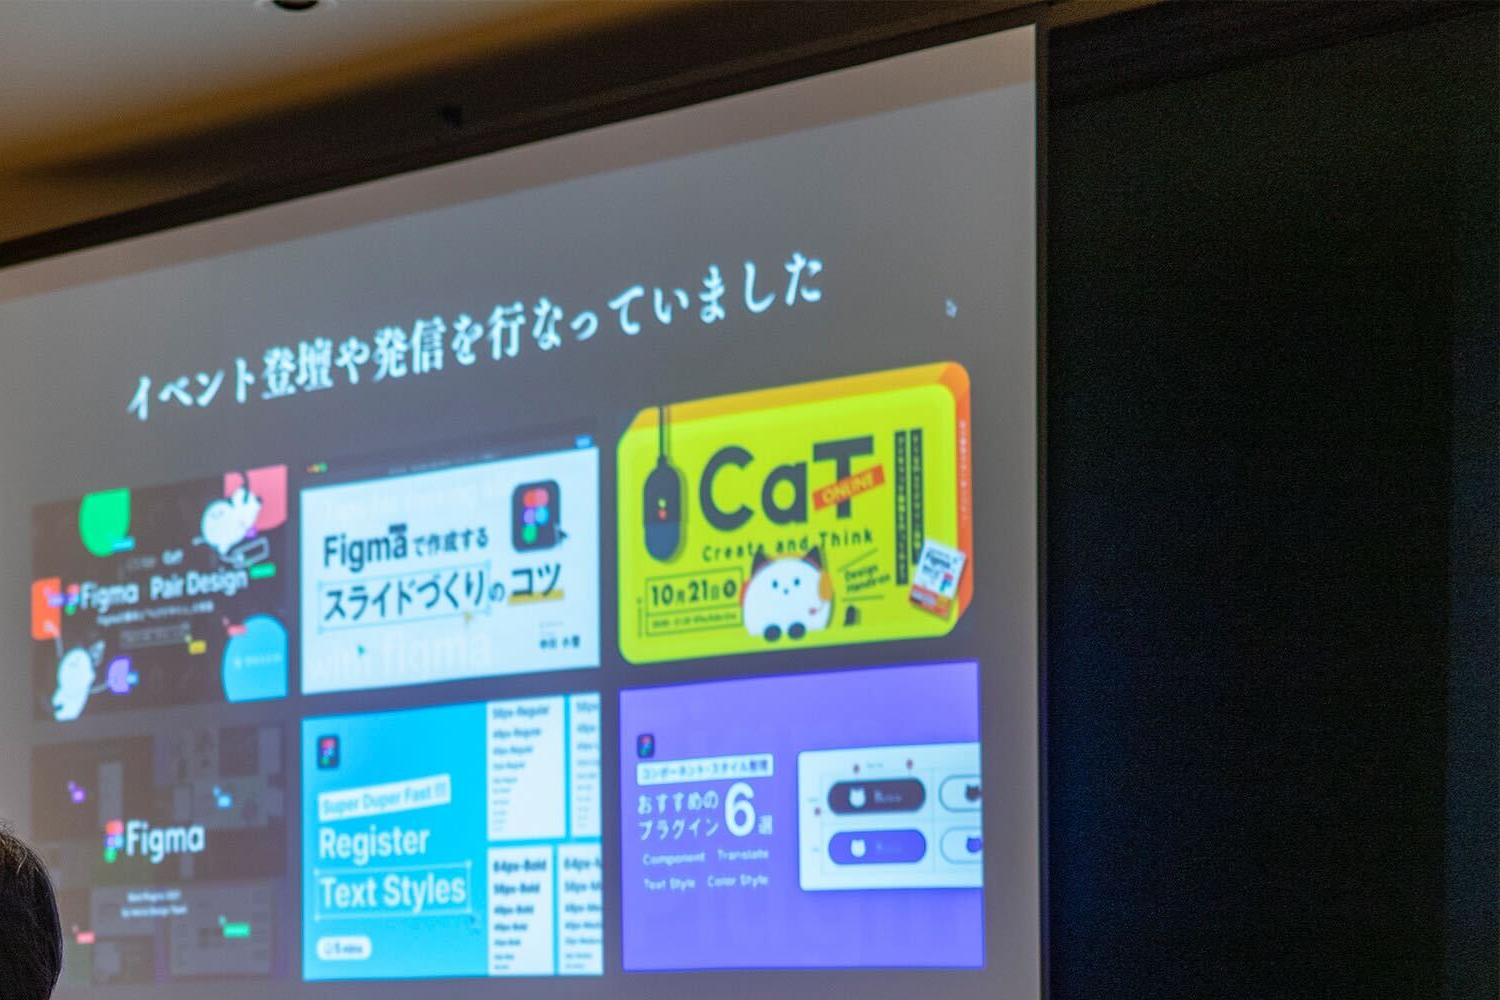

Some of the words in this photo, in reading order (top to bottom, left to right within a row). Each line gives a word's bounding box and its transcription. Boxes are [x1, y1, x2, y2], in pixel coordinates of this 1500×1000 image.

[127, 252, 823, 421] イベント登壇や発信を行なっていました
[700, 436, 874, 532] CaT
[776, 536, 808, 552] and
[819, 529, 873, 549] Think
[81, 580, 139, 614] Figma
[150, 573, 184, 600] Pair
[186, 567, 248, 597] Design
[638, 790, 719, 815] おすすめの
[126, 820, 205, 864] Figma
[319, 824, 430, 866] Register
[639, 818, 719, 840] プラグイン
[643, 852, 705, 867] Component
[319, 876, 377, 909] Text
[383, 872, 466, 914] Styles
